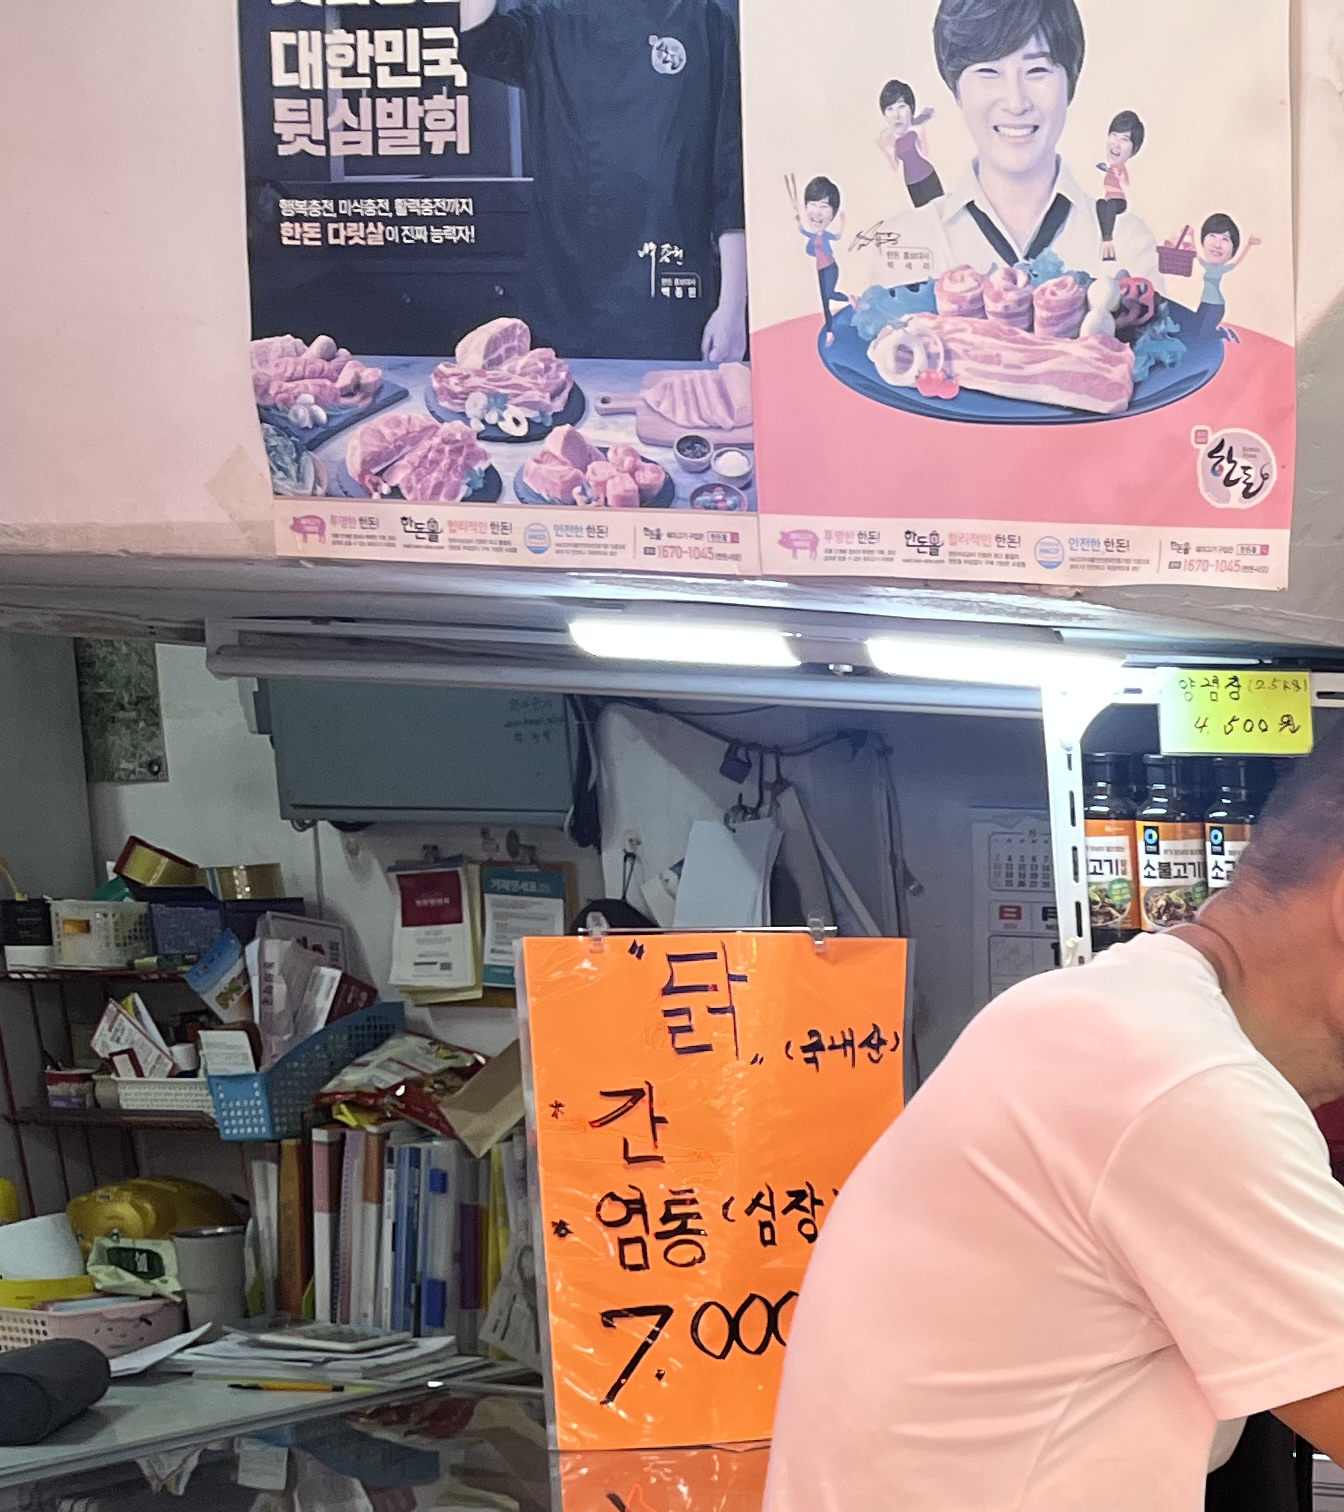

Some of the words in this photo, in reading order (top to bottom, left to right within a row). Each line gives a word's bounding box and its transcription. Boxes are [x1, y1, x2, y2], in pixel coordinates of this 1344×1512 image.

[269, 26, 468, 90] 대한민국
[272, 94, 470, 157] 뒷심발휘
[280, 222, 322, 246] 한돈
[327, 222, 400, 246] 다릿살이
[401, 225, 428, 244] 진짜
[430, 225, 476, 245] 능력자!
[338, 198, 392, 218] 미식충전,
[1143, 858, 1201, 880] 소불고기
[784, 1022, 901, 1073] (국내산)
[588, 1079, 669, 1166] 간
[595, 1184, 708, 1272] 염통
